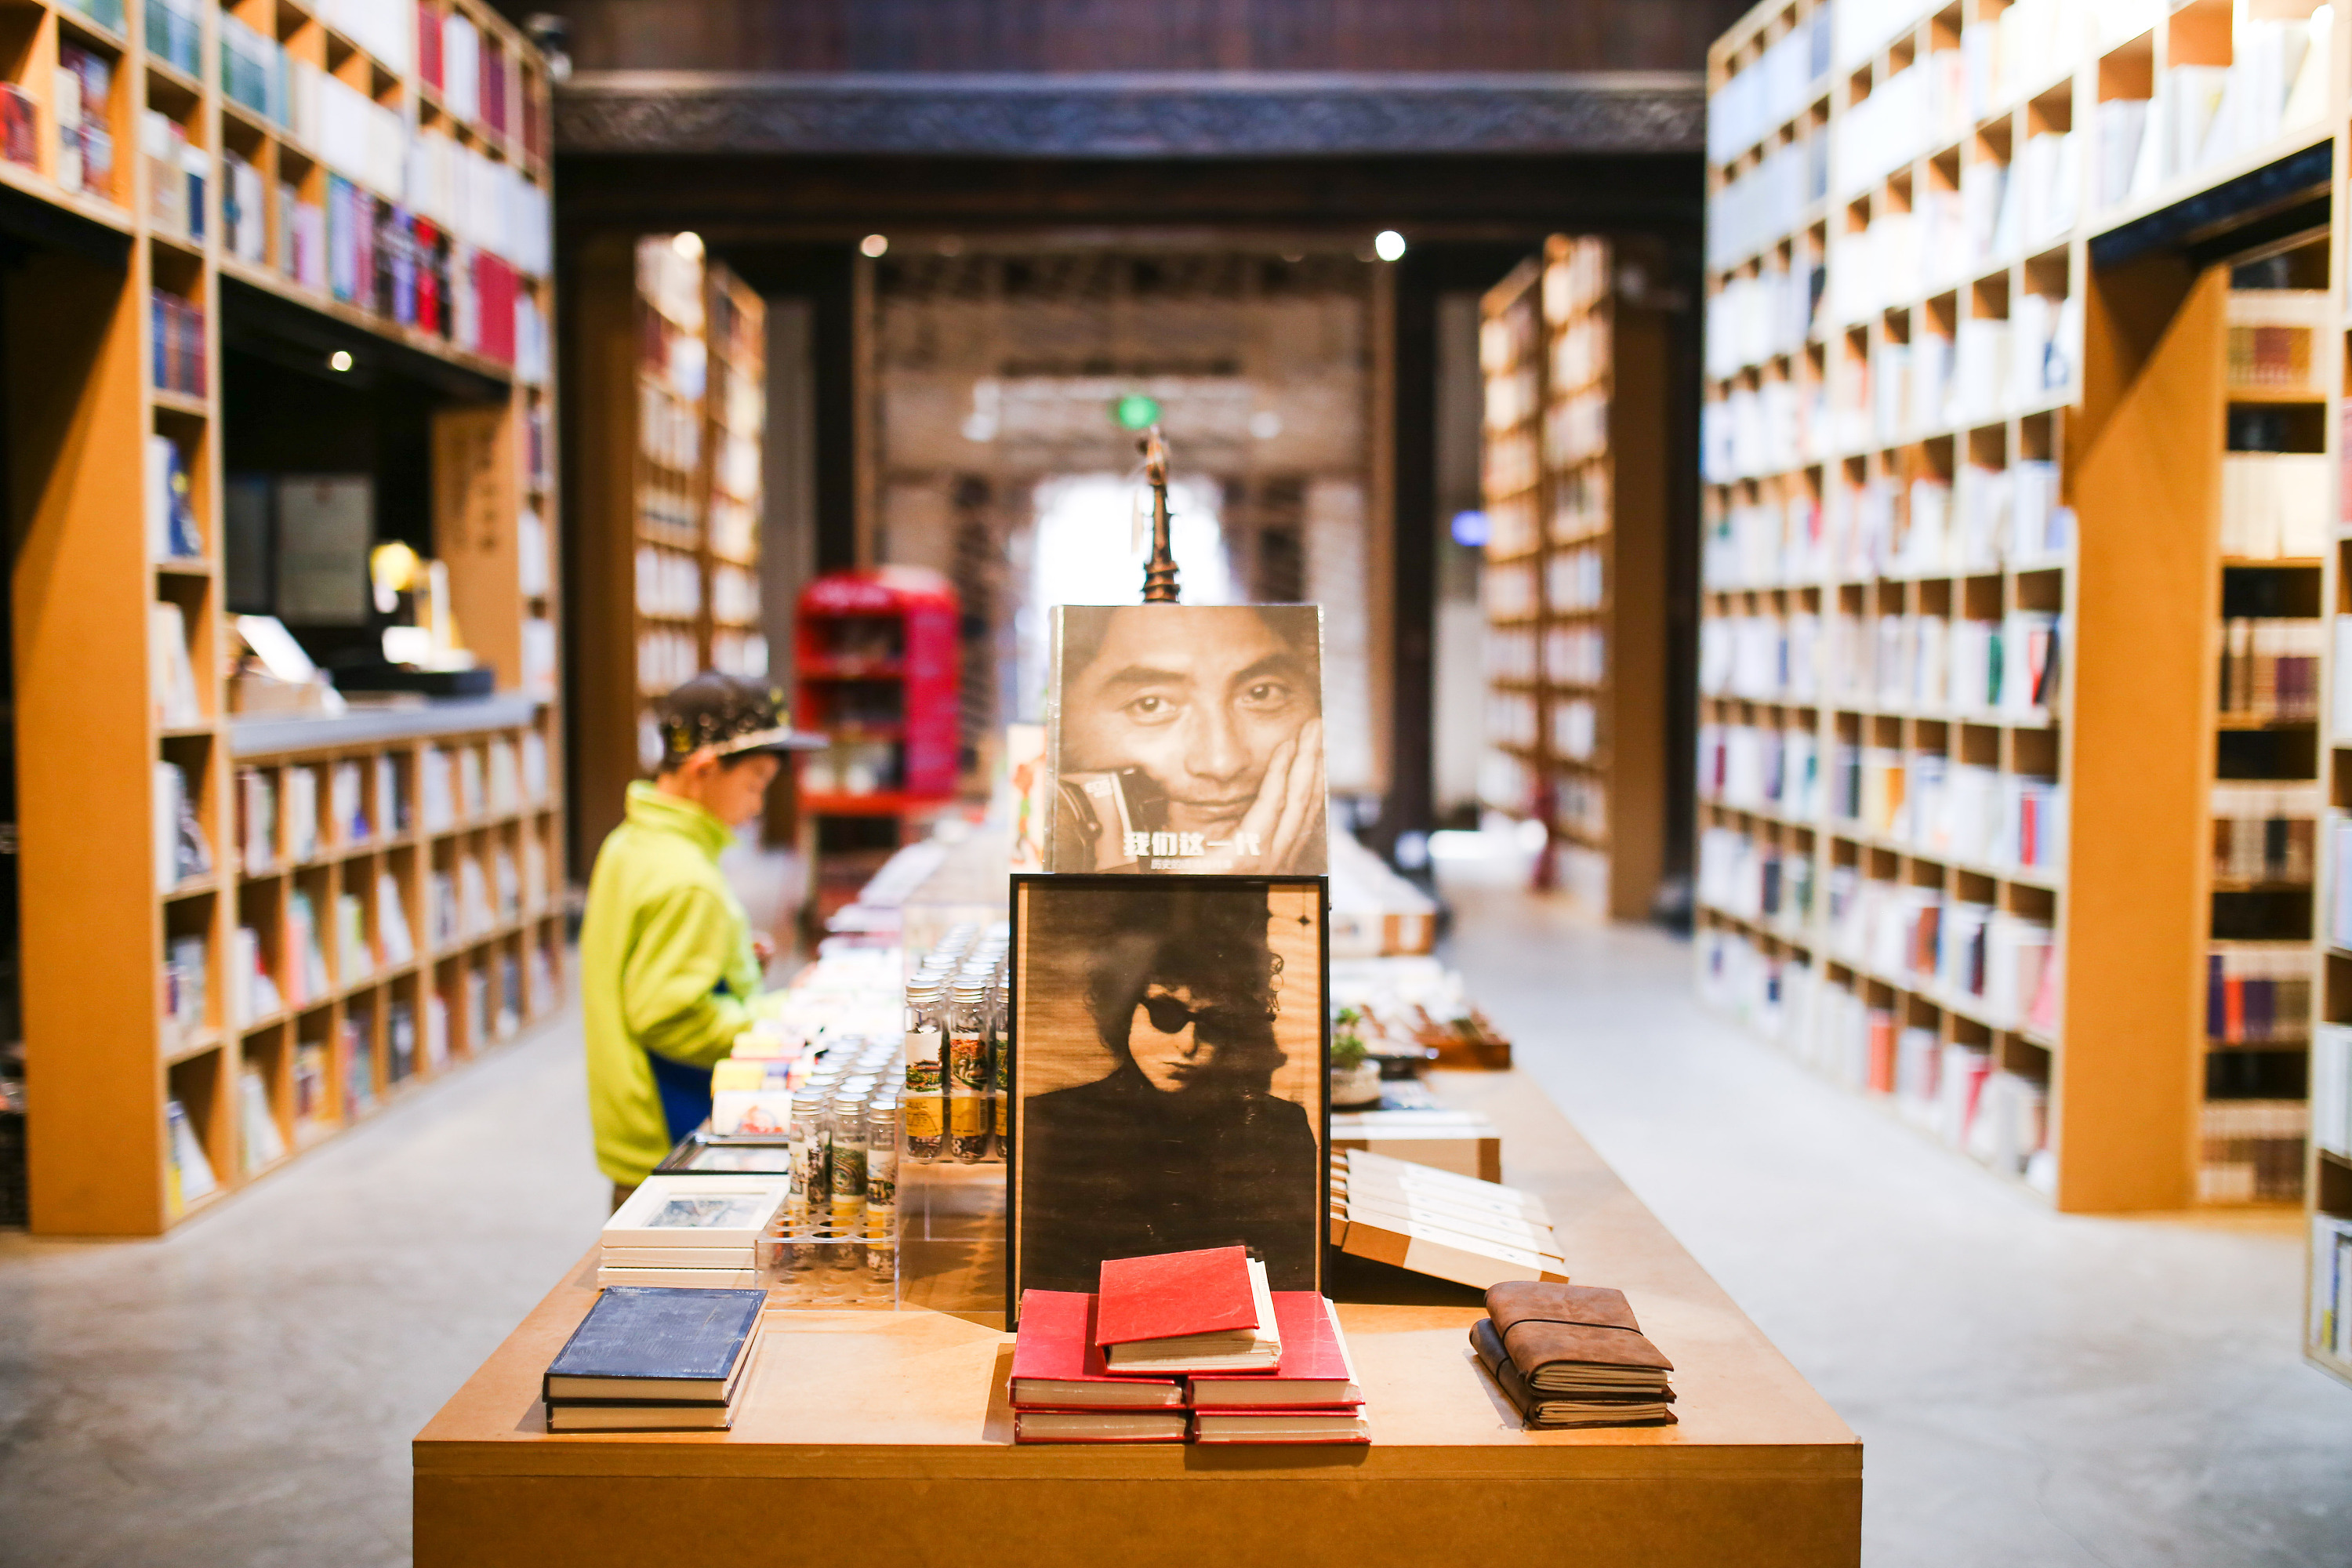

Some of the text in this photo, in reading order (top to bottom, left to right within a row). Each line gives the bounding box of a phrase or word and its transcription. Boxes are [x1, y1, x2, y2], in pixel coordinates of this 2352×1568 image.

[1123, 831, 1260, 856] 我们这一代
